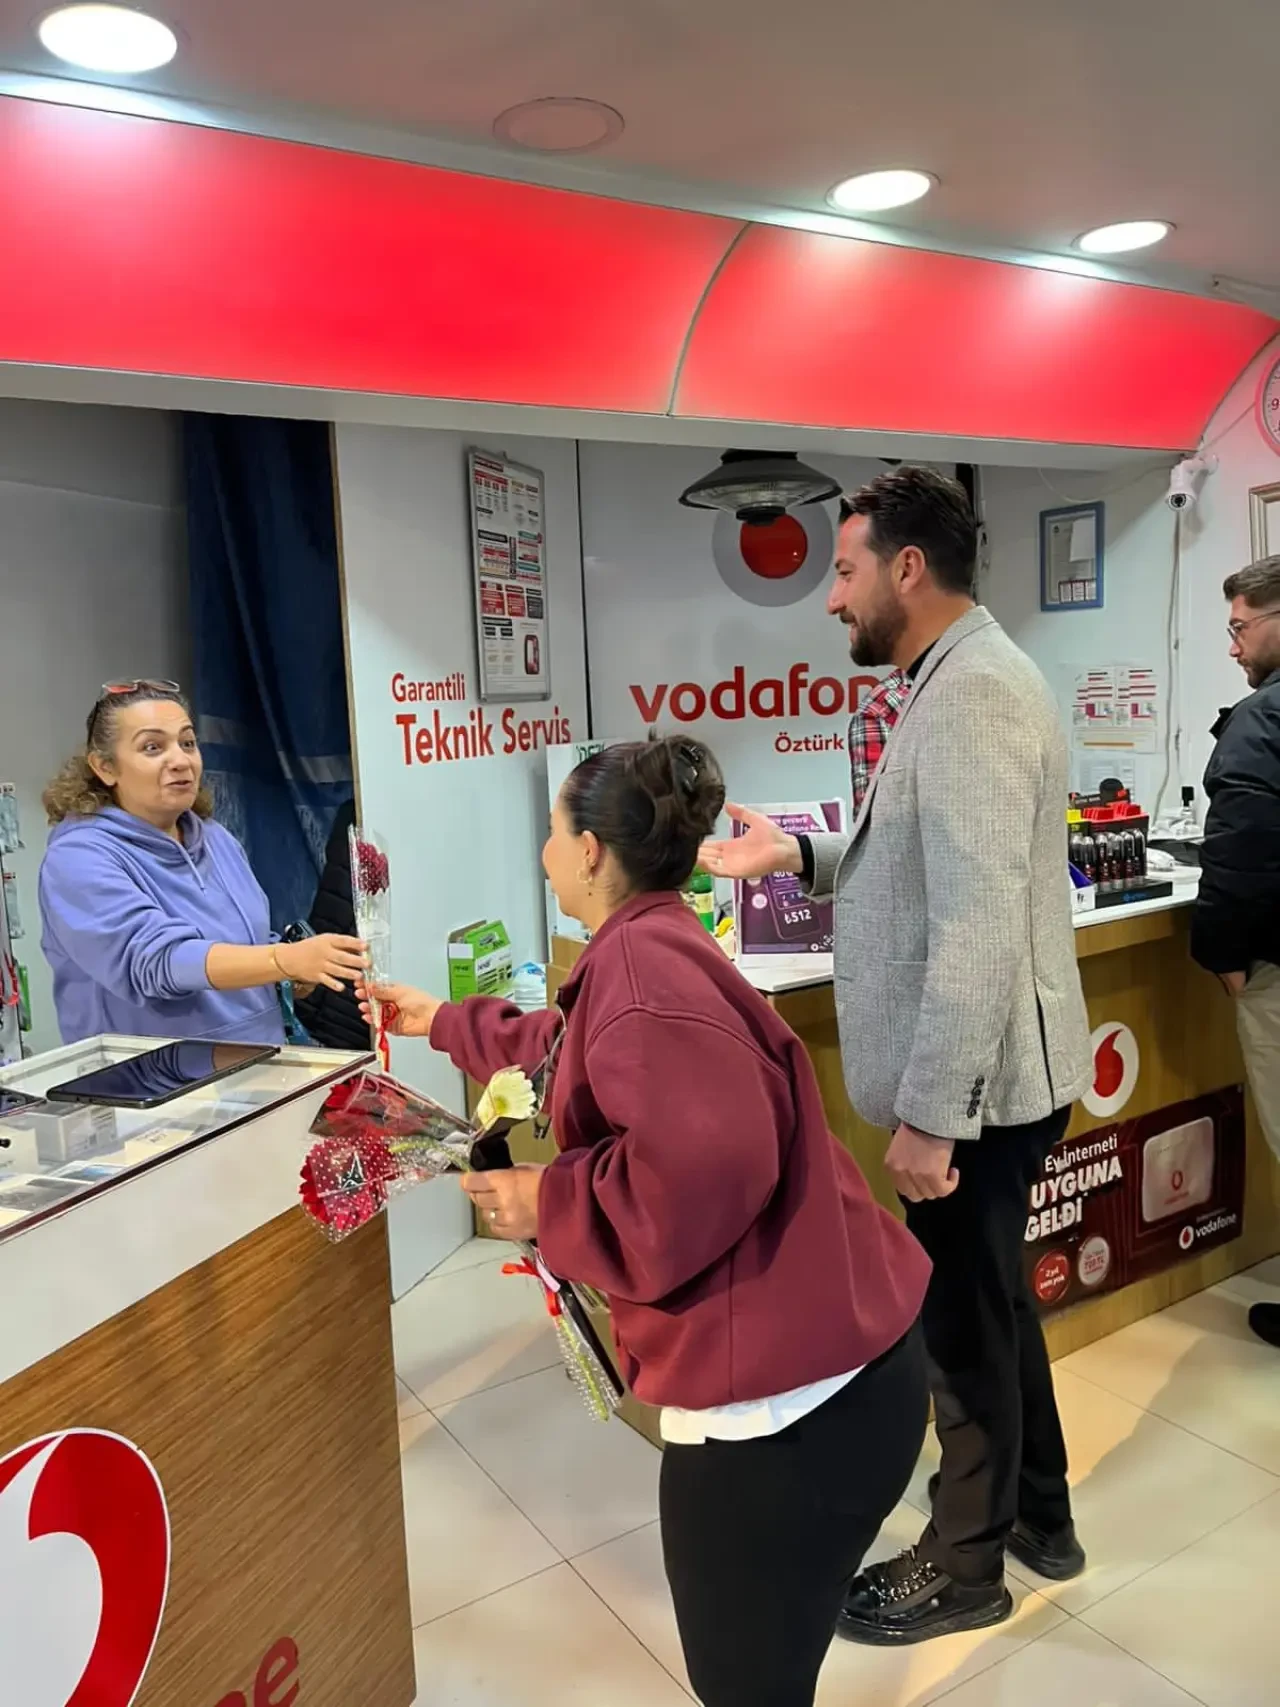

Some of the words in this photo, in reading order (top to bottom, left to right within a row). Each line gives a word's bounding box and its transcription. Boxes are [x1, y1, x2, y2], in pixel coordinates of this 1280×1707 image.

[391, 672, 466, 702] Garantili
[629, 663, 881, 723] vodafon
[395, 707, 495, 766] Teknik
[502, 705, 572, 755] Servis
[774, 732, 845, 753] Öztürk
[1044, 1154, 1063, 1173] Ev
[1031, 1156, 1123, 1209] UYGUNA
[1195, 1213, 1237, 1238] vodafone
